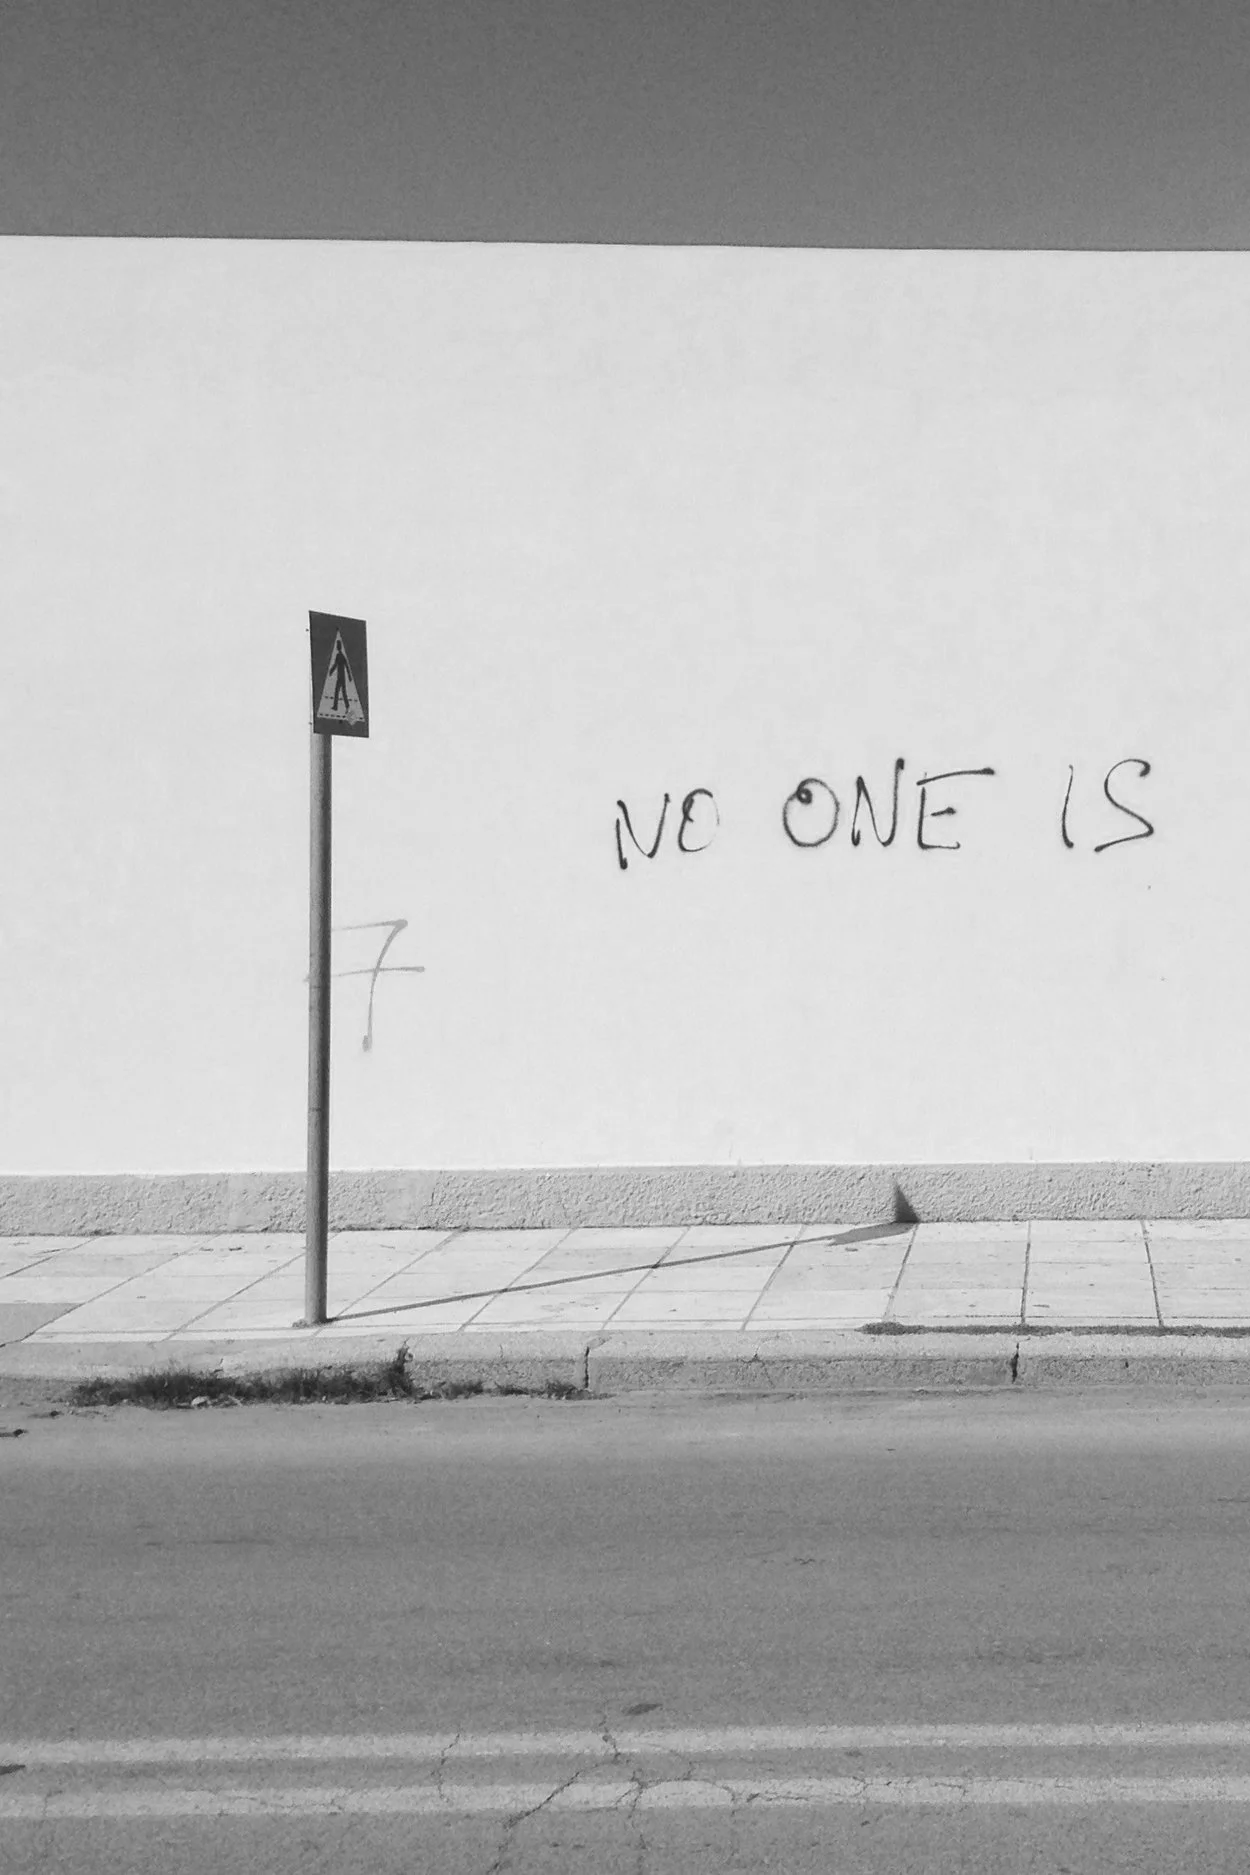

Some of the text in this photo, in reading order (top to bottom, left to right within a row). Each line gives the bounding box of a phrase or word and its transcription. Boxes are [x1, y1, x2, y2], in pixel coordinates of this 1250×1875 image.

[614, 787, 720, 871] NO
[782, 757, 997, 852] ONE
[1061, 758, 1155, 854] IS
